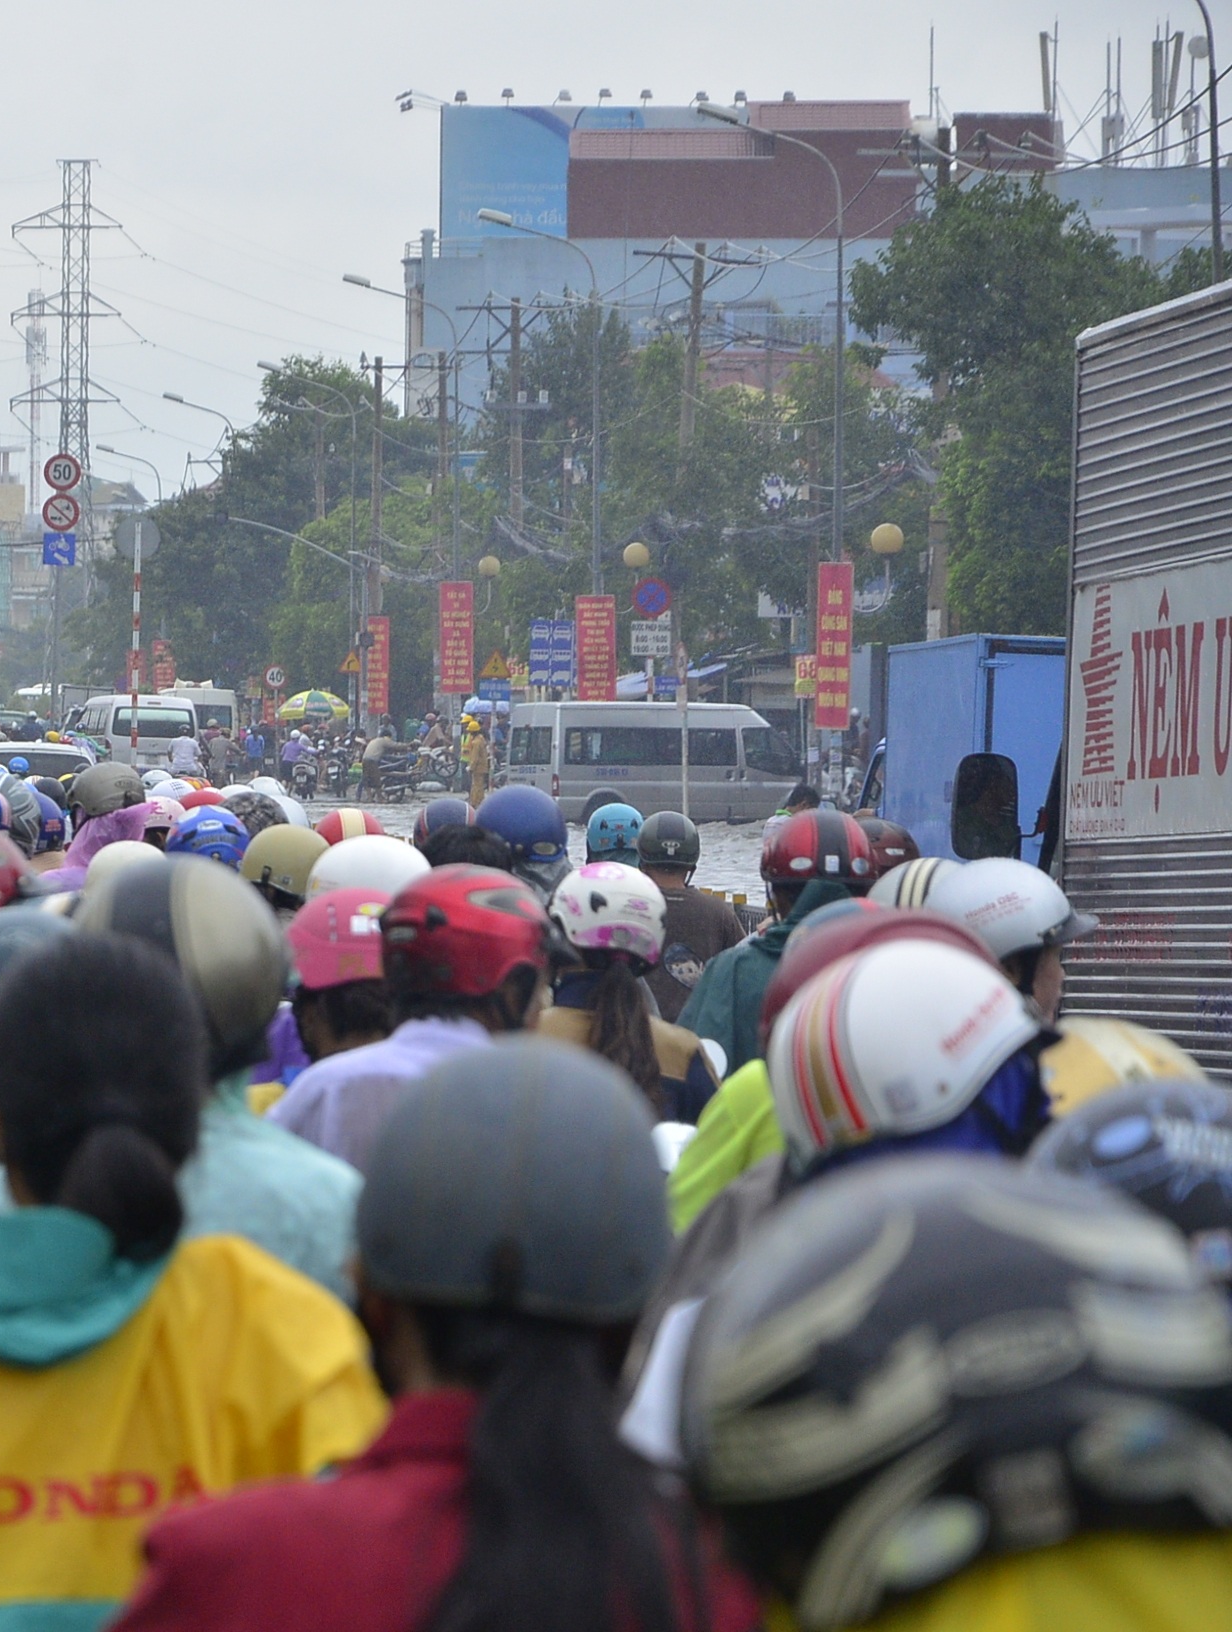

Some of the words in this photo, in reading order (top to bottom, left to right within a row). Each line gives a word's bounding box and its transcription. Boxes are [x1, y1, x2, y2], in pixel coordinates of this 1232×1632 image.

[52, 464, 72, 480] 50
[268, 670, 283, 683] 40
[1127, 586, 1205, 814] NỆM
